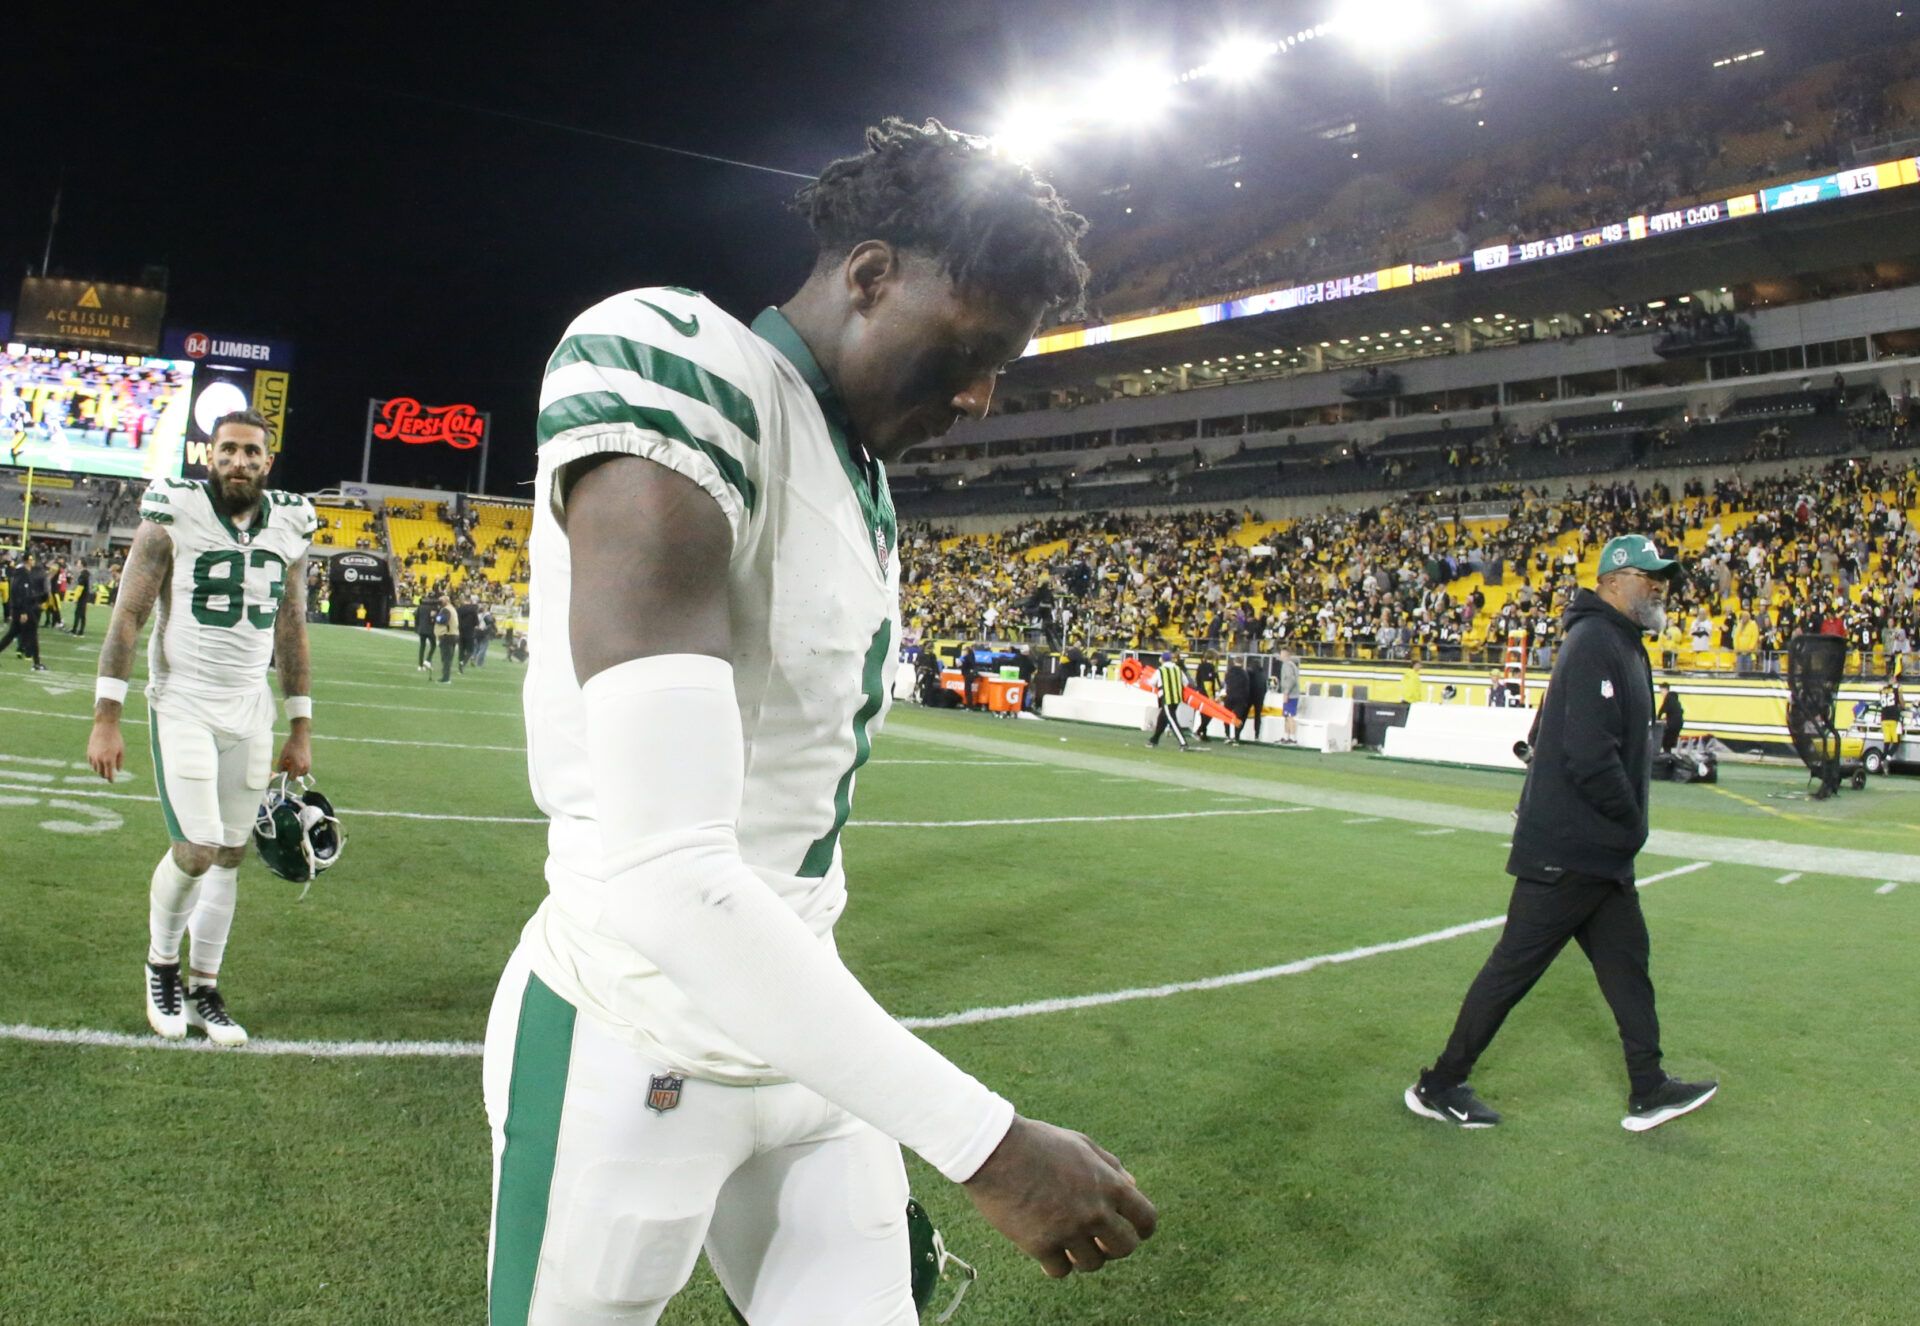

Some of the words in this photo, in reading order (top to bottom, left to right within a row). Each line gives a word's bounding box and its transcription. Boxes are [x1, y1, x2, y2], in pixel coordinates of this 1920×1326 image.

[1853, 174, 1872, 190] 15
[1650, 211, 1682, 232] 4TH
[1687, 204, 1719, 225] 0:00
[1519, 240, 1545, 261] 1ST
[1556, 234, 1575, 252] 10
[1414, 261, 1461, 283] Steelers
[47, 308, 131, 328] ACRISURE
[60, 324, 111, 338] STADIUM
[187, 336, 207, 353] 84
[211, 340, 271, 361] LUMBER
[263, 376, 284, 448] UPMC
[191, 549, 287, 629] 83
[1006, 687, 1019, 704] G
